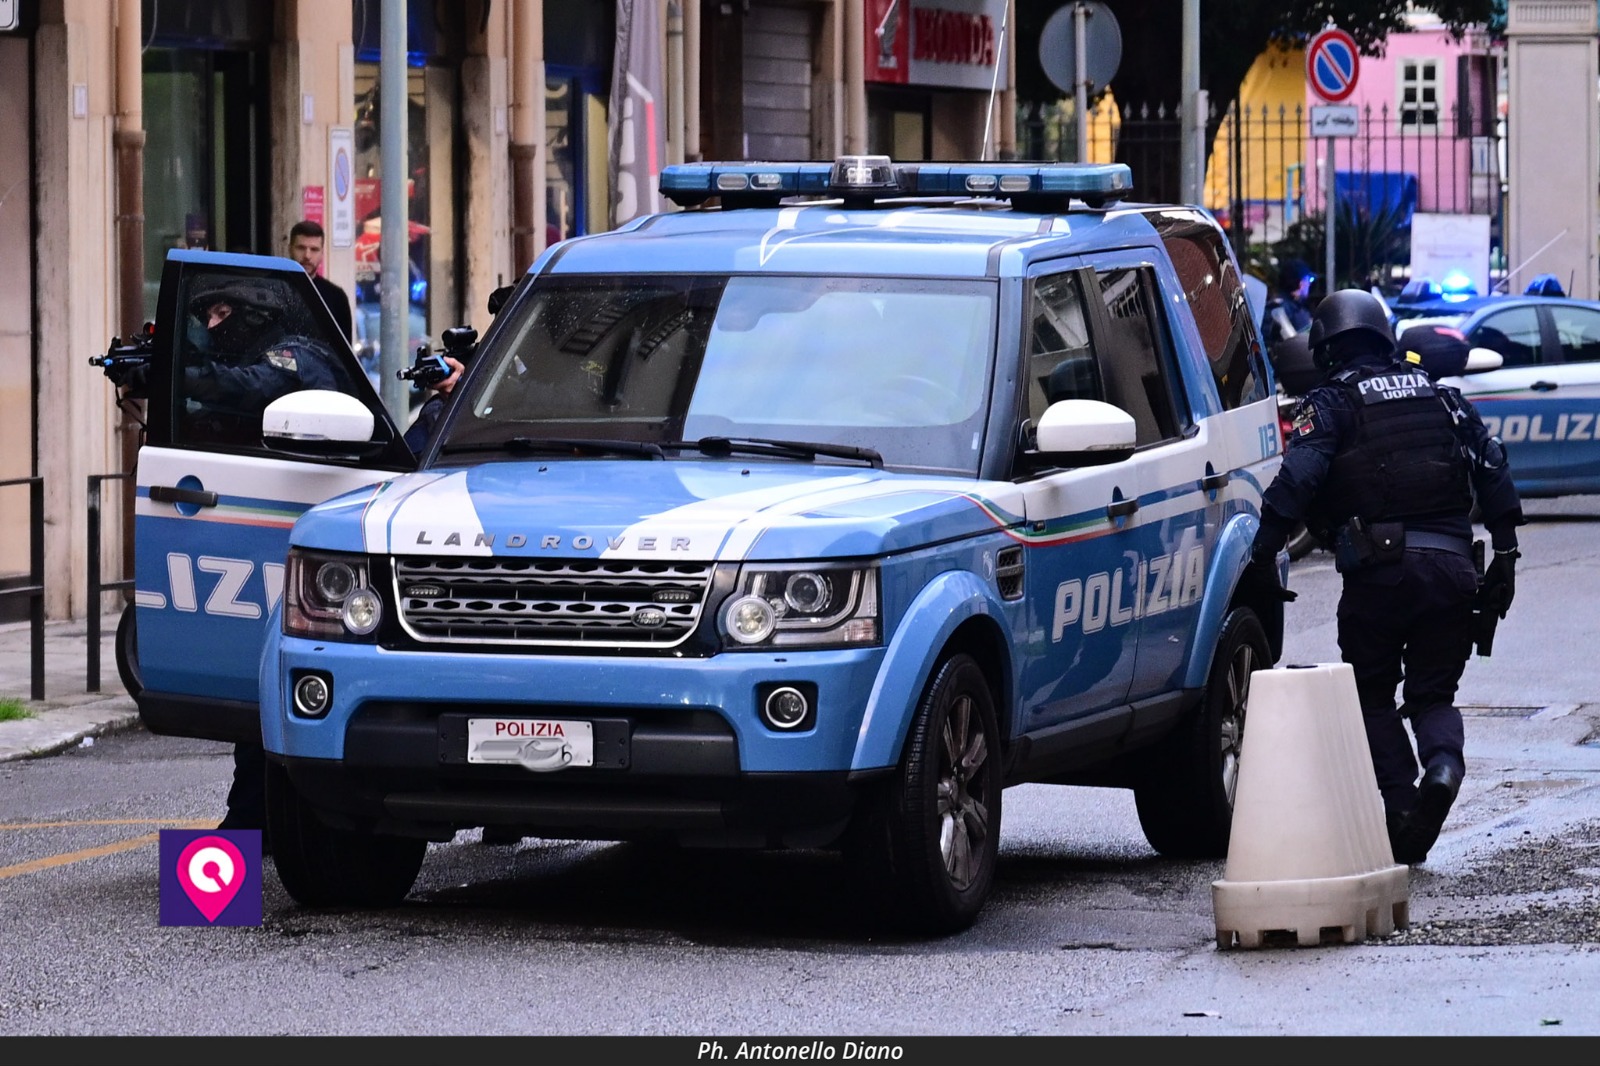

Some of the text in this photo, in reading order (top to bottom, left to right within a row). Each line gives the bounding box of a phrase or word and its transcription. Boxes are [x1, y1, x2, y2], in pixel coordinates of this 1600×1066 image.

[1358, 374, 1430, 395] POLIZIA
[1382, 388, 1416, 399] UOPI
[1258, 422, 1278, 459] 113
[1052, 545, 1205, 643] POLIZIA
[495, 722, 564, 737] POLIZIA
